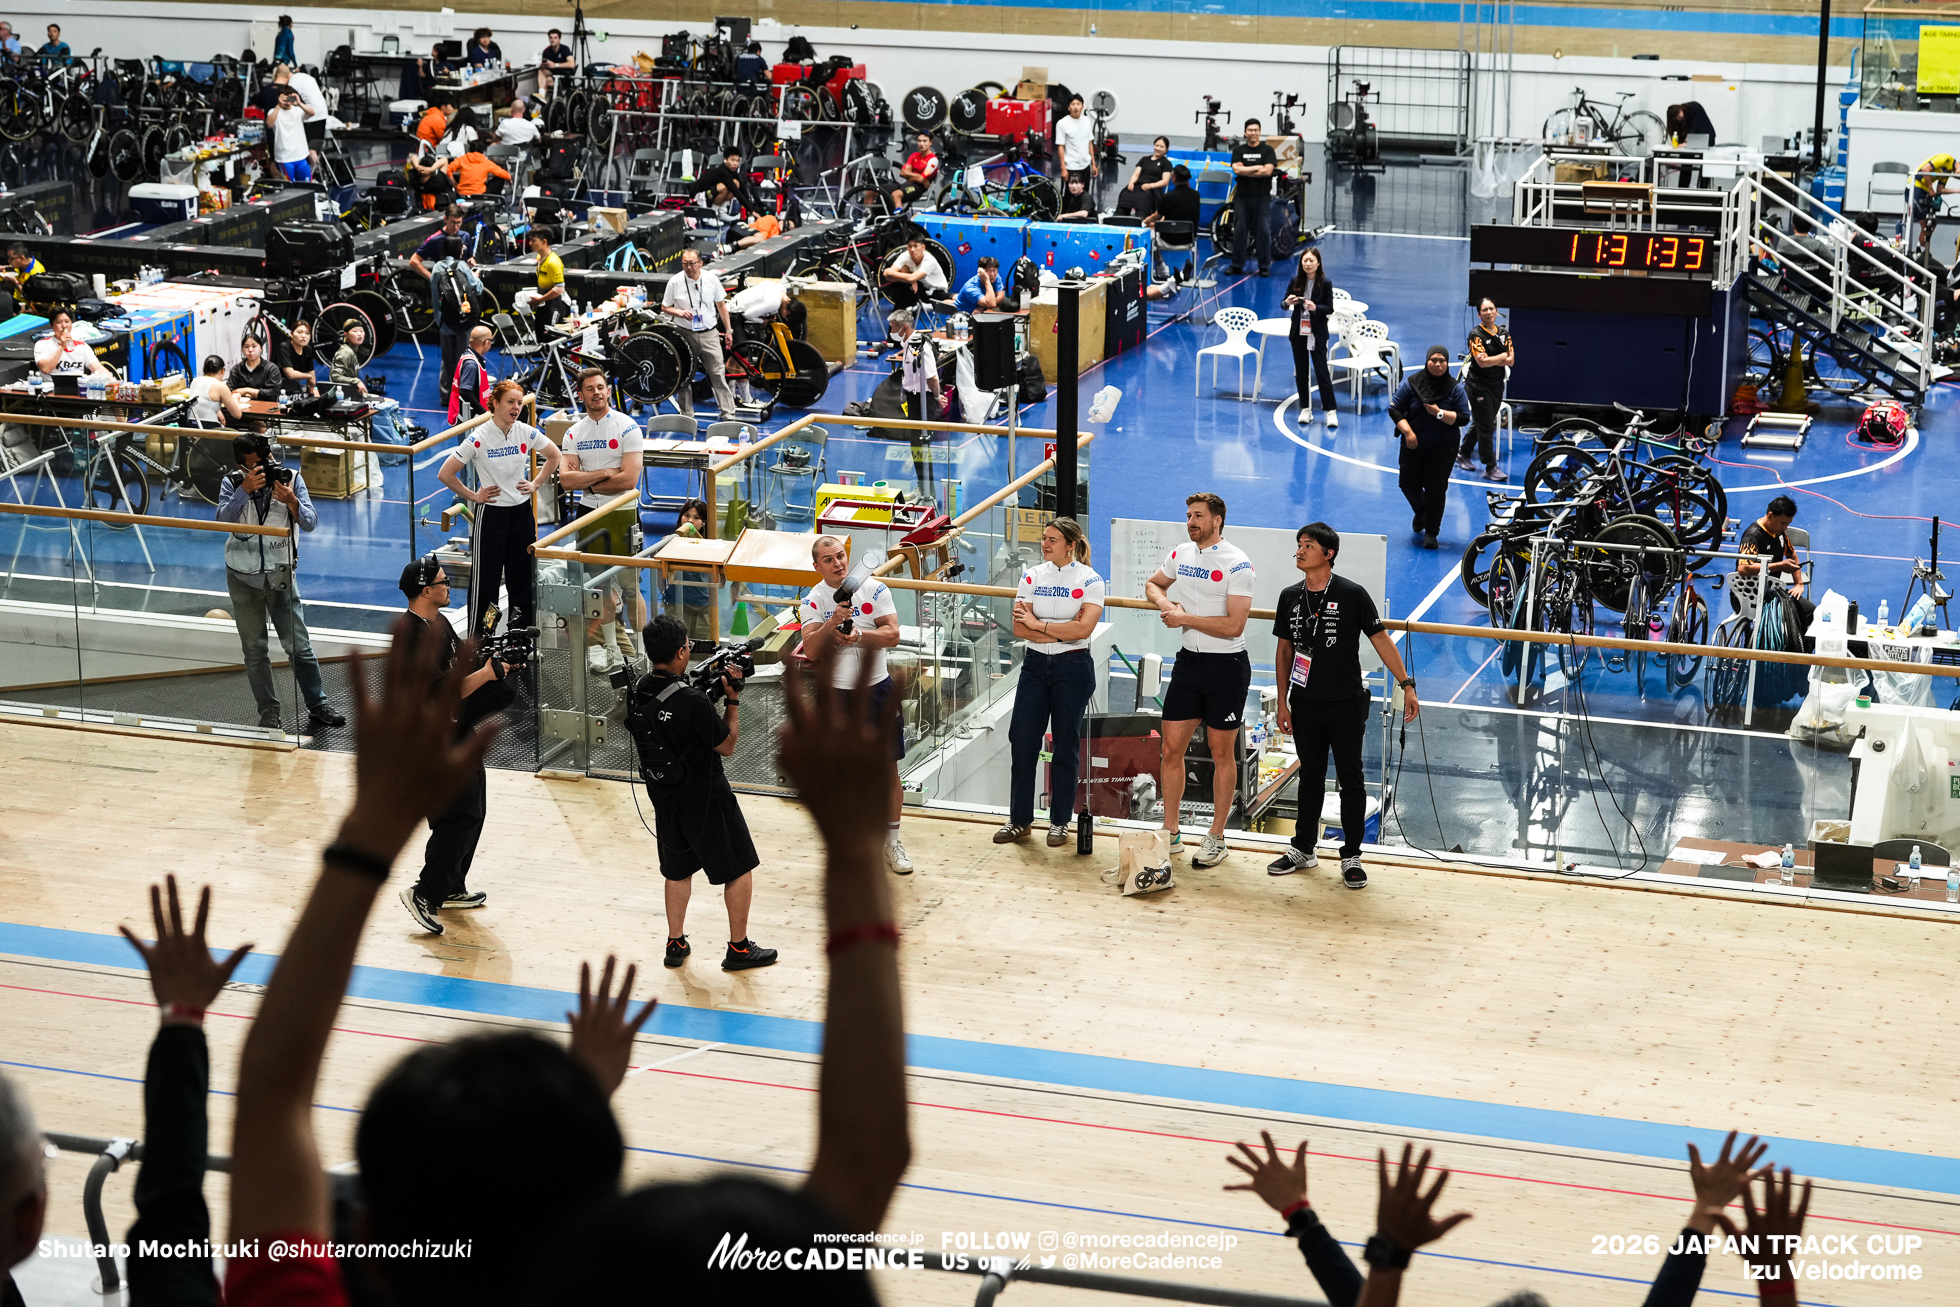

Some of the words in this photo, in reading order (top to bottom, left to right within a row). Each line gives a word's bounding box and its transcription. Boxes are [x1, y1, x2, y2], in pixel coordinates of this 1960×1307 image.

[593, 439, 607, 449] 2026
[504, 445, 519, 456] 2026
[125, 445, 171, 476] BRIDGESTONE
[1192, 566, 1210, 580] 2026
[1052, 586, 1070, 598] 2026
[1884, 645, 1908, 654] PLASTIC
[657, 710, 673, 722] CF
